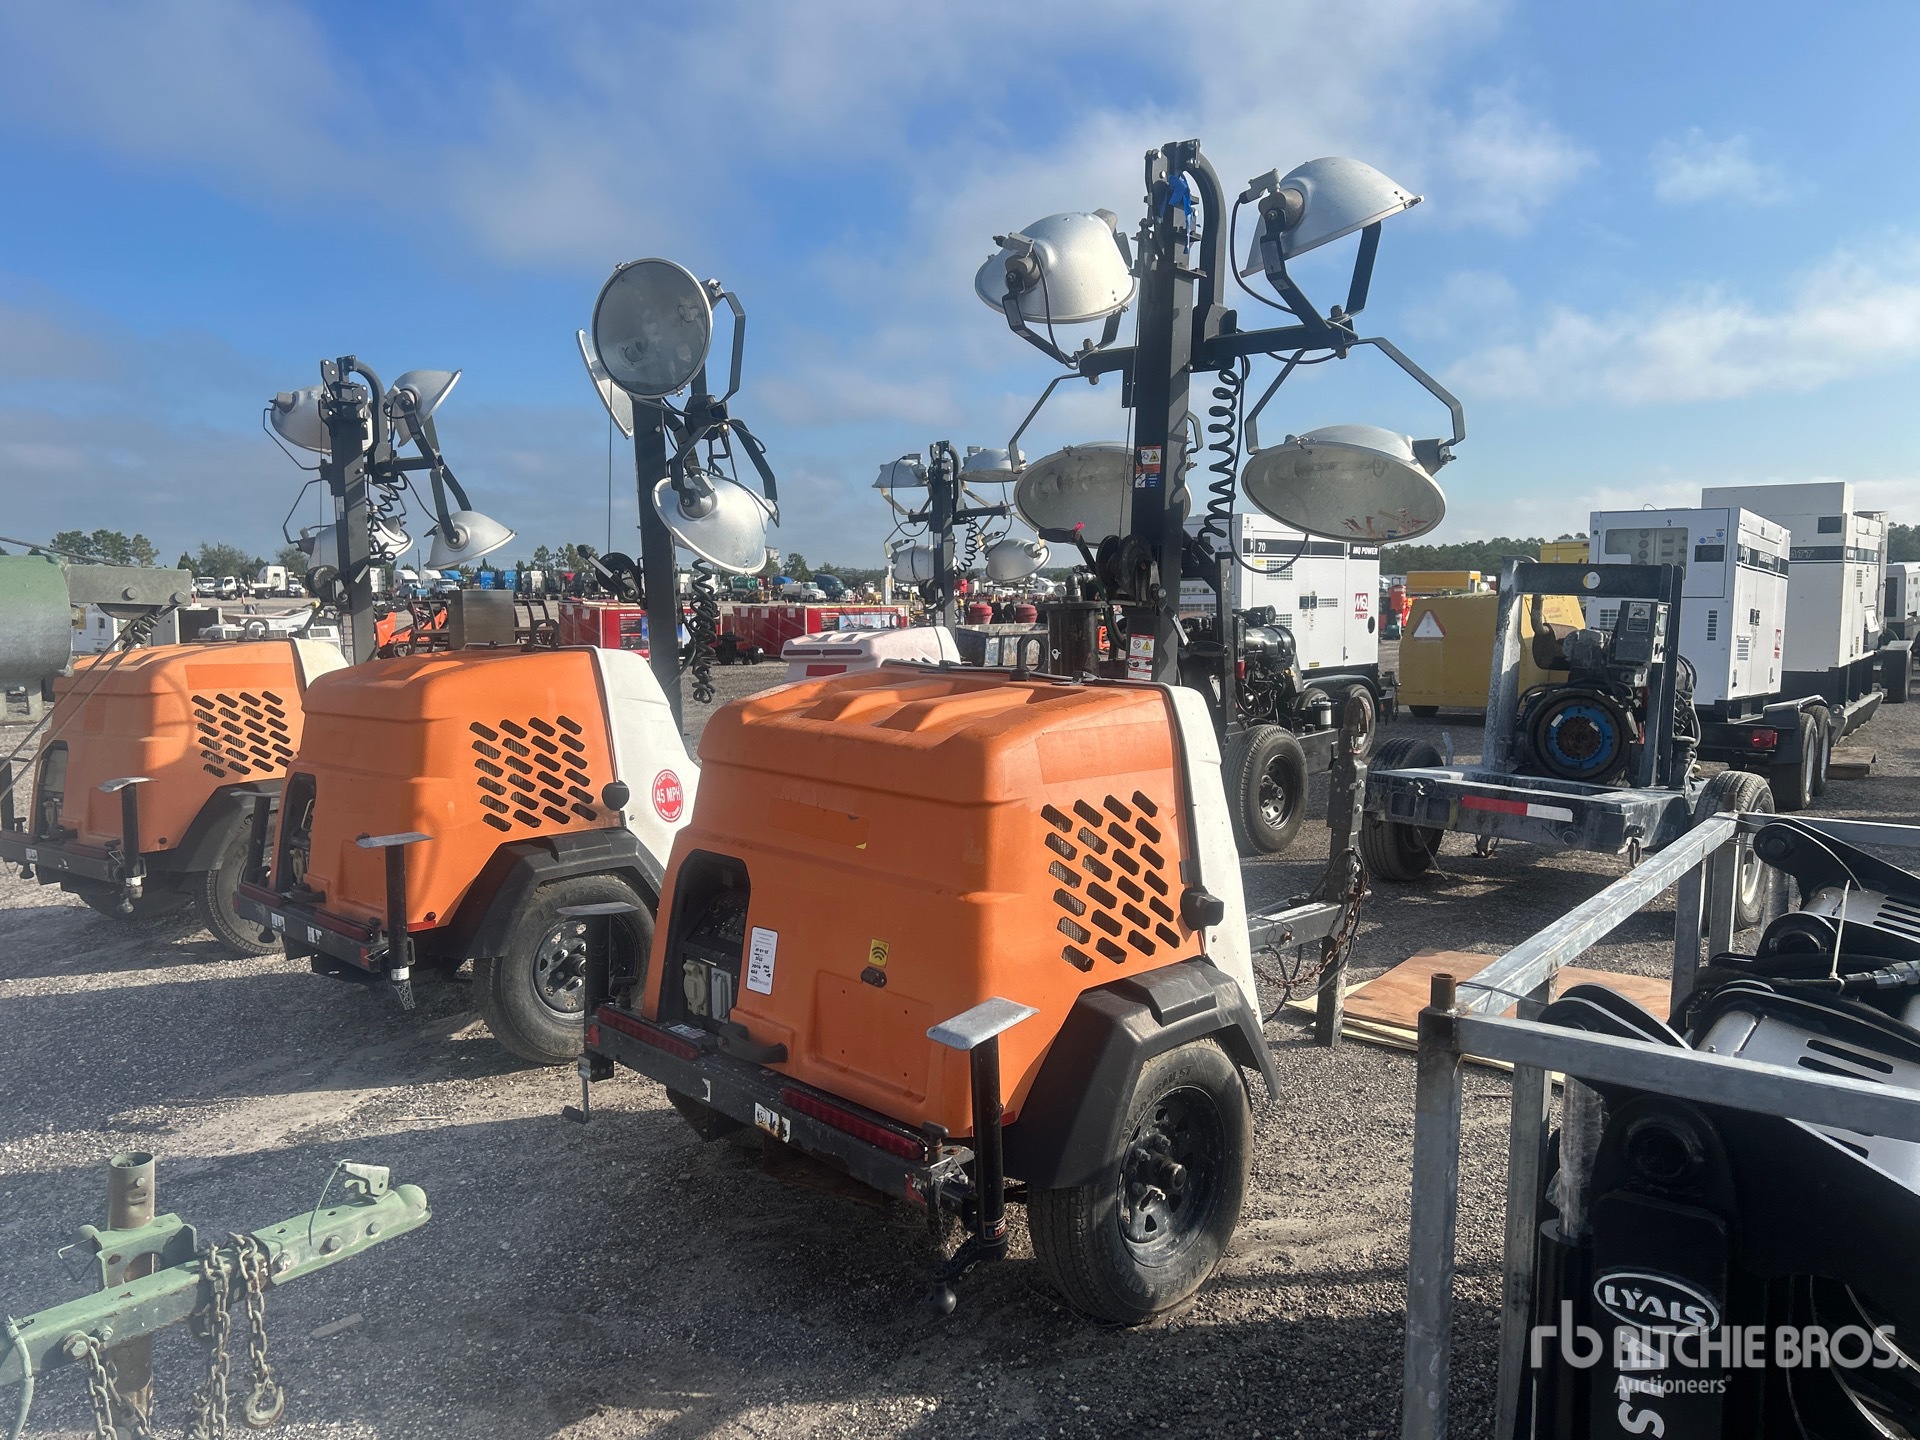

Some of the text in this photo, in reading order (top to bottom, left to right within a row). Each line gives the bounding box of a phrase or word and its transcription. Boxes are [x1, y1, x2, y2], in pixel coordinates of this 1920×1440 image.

[1258, 542, 1266, 552] 70
[1353, 546, 1378, 555] MQ POWER
[1355, 594, 1368, 611] MQ
[656, 786, 682, 804] 45 MPH
[1603, 1285, 1707, 1327] LYALS
